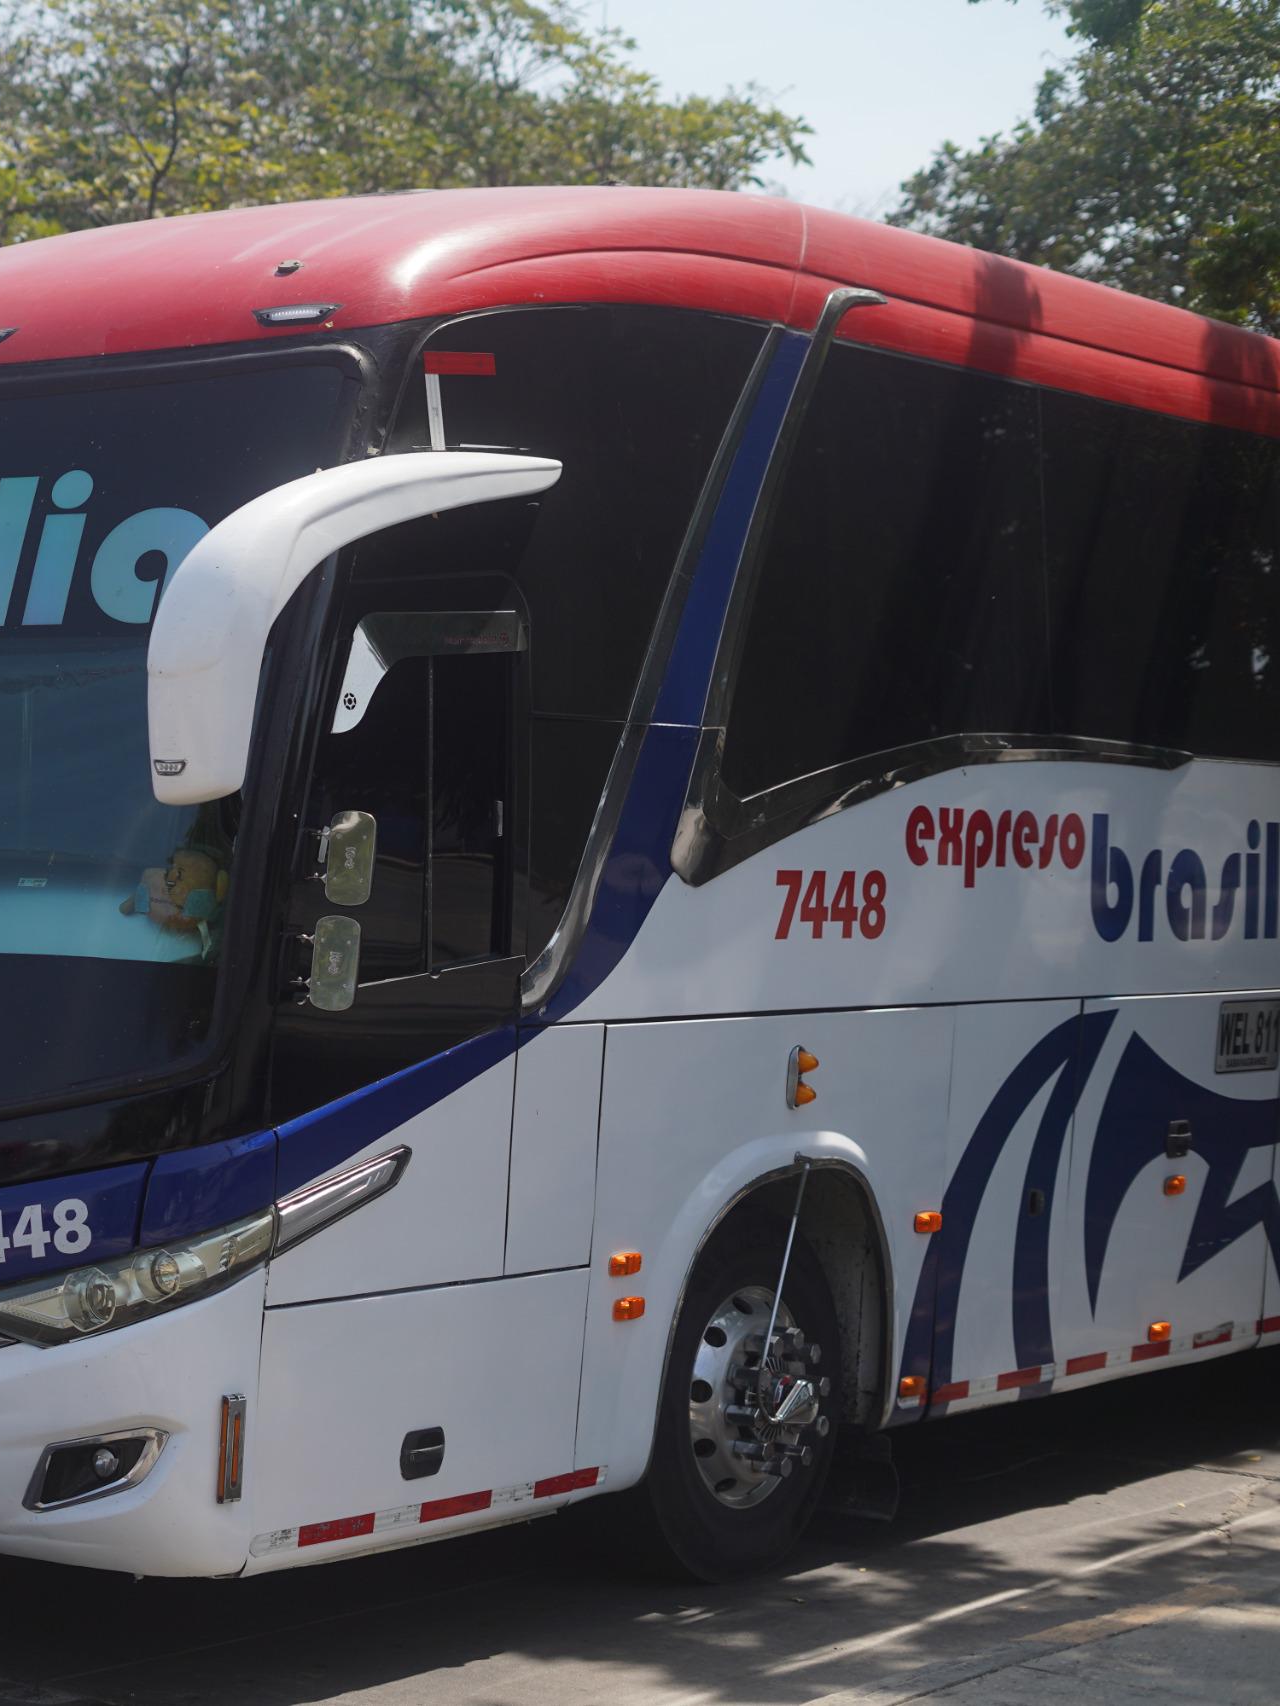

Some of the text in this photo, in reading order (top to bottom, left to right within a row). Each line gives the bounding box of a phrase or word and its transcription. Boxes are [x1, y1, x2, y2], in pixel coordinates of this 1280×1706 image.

[905, 805, 1086, 888] expreso
[774, 869, 887, 940] 7448
[1219, 1012, 1249, 1056] WEL
